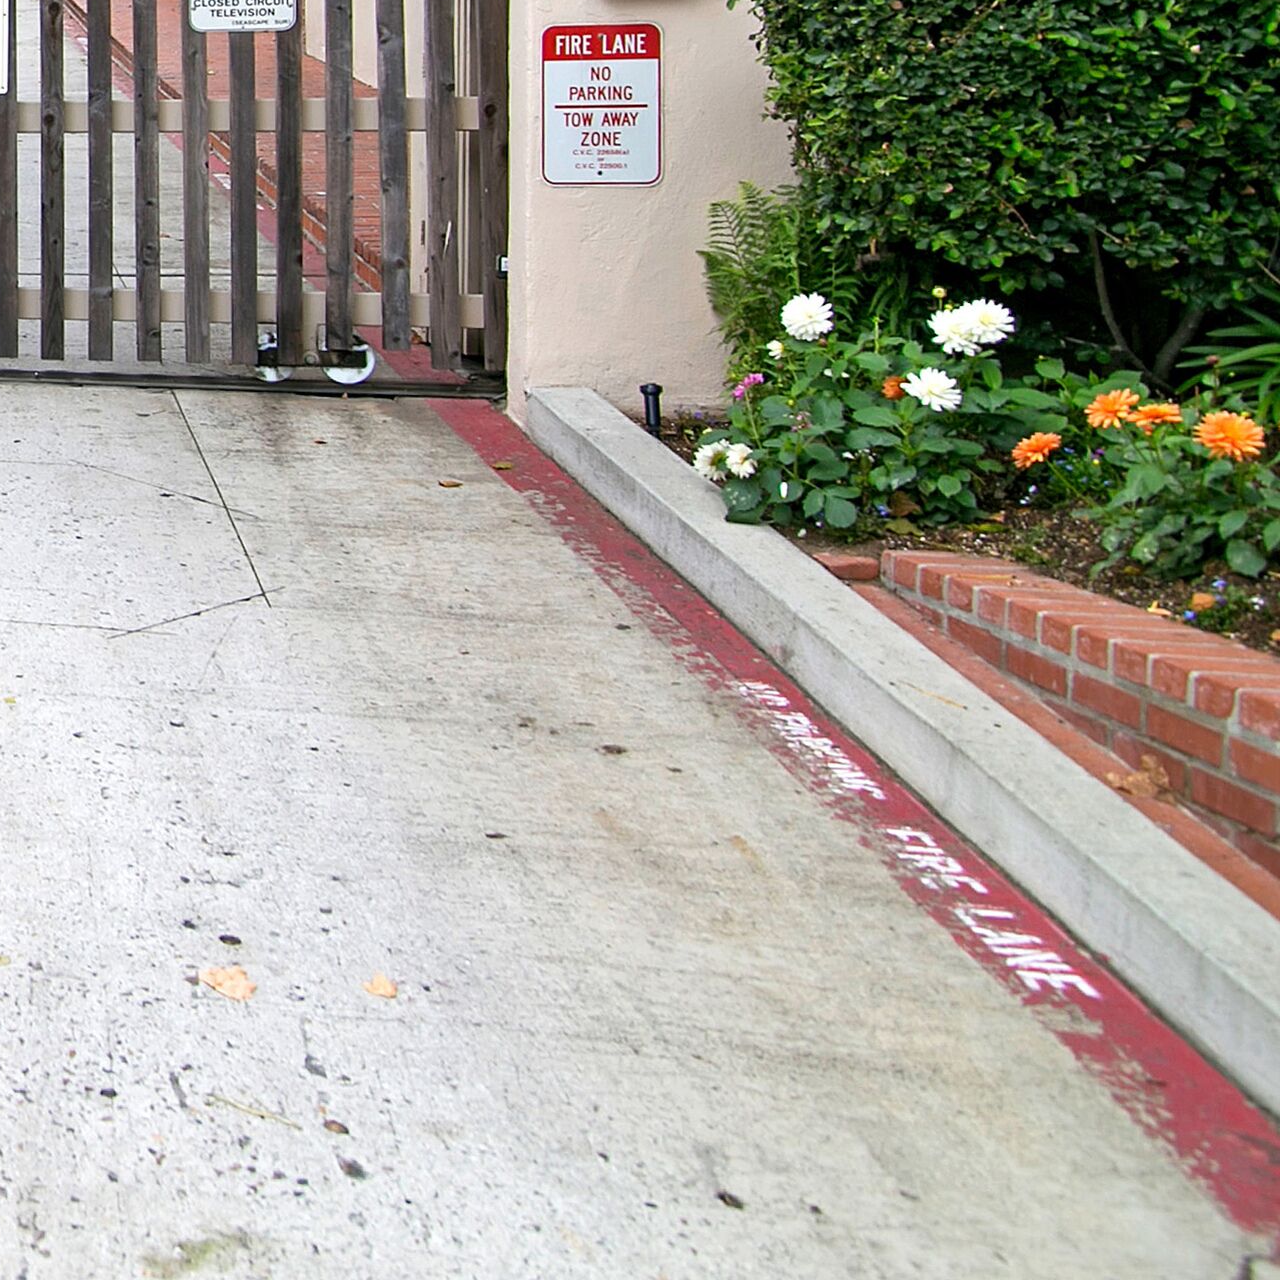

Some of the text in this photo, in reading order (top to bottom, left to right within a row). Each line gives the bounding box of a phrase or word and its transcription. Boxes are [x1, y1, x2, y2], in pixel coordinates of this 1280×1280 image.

[209, 7, 276, 18] TELEVISION
[555, 33, 647, 56] FIRE LANE
[590, 66, 612, 81] NO
[569, 85, 633, 102] PARKING
[563, 112, 639, 127] TOW AWAY
[581, 131, 622, 147] ZONE
[886, 826, 988, 894] FIRE
[953, 903, 1103, 1000] LANE
